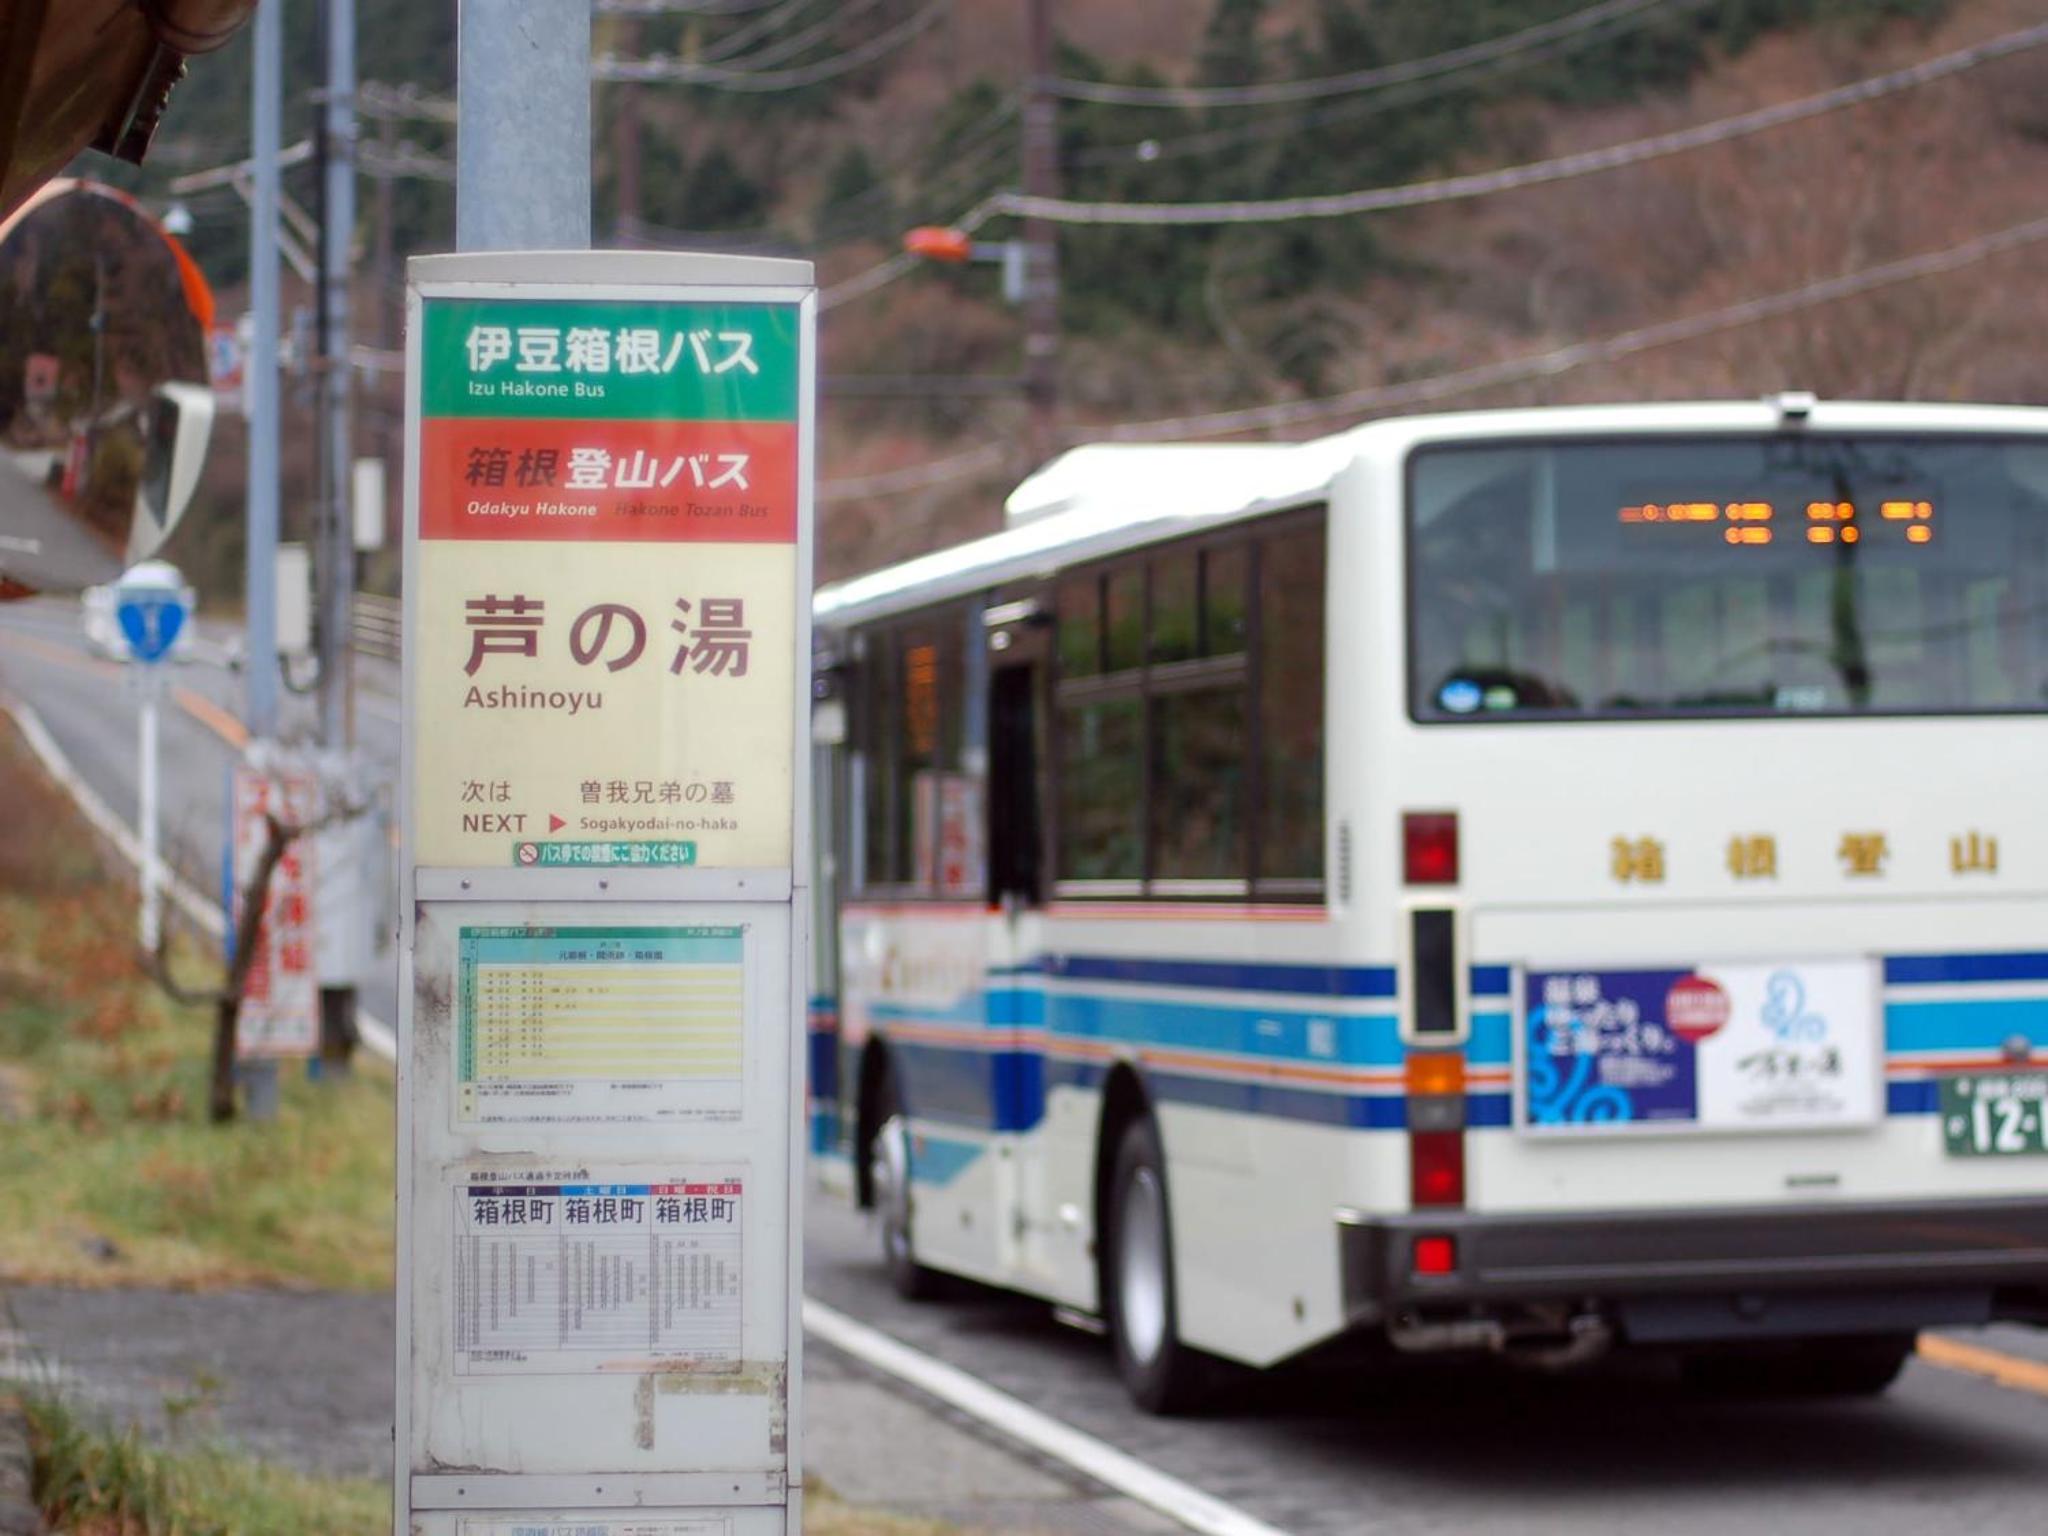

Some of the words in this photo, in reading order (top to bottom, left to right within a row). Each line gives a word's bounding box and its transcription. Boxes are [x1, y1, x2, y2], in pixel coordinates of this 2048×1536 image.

[466, 326, 758, 375] 伊豆箱根バス
[468, 381, 495, 397] Izu
[500, 381, 569, 397] Hakone
[574, 382, 605, 398] Bus
[464, 448, 750, 490] 箱根登山バス
[467, 501, 529, 517] Odakyu
[535, 502, 598, 517] Hakone
[613, 502, 680, 518] Hakone
[686, 503, 733, 518] Tozan
[738, 503, 768, 518] Bus
[463, 594, 753, 678] 芦の湯
[463, 684, 603, 715] Ashinoyu
[461, 780, 512, 804] 次は
[580, 780, 736, 805] 曽我兄弟の墓
[462, 813, 527, 833] NEXT
[580, 816, 738, 833] Sogakyodai-no-haka
[474, 1198, 554, 1225] 箱根町
[565, 1198, 645, 1225] 箱根町
[655, 1197, 734, 1224] 箱根町
